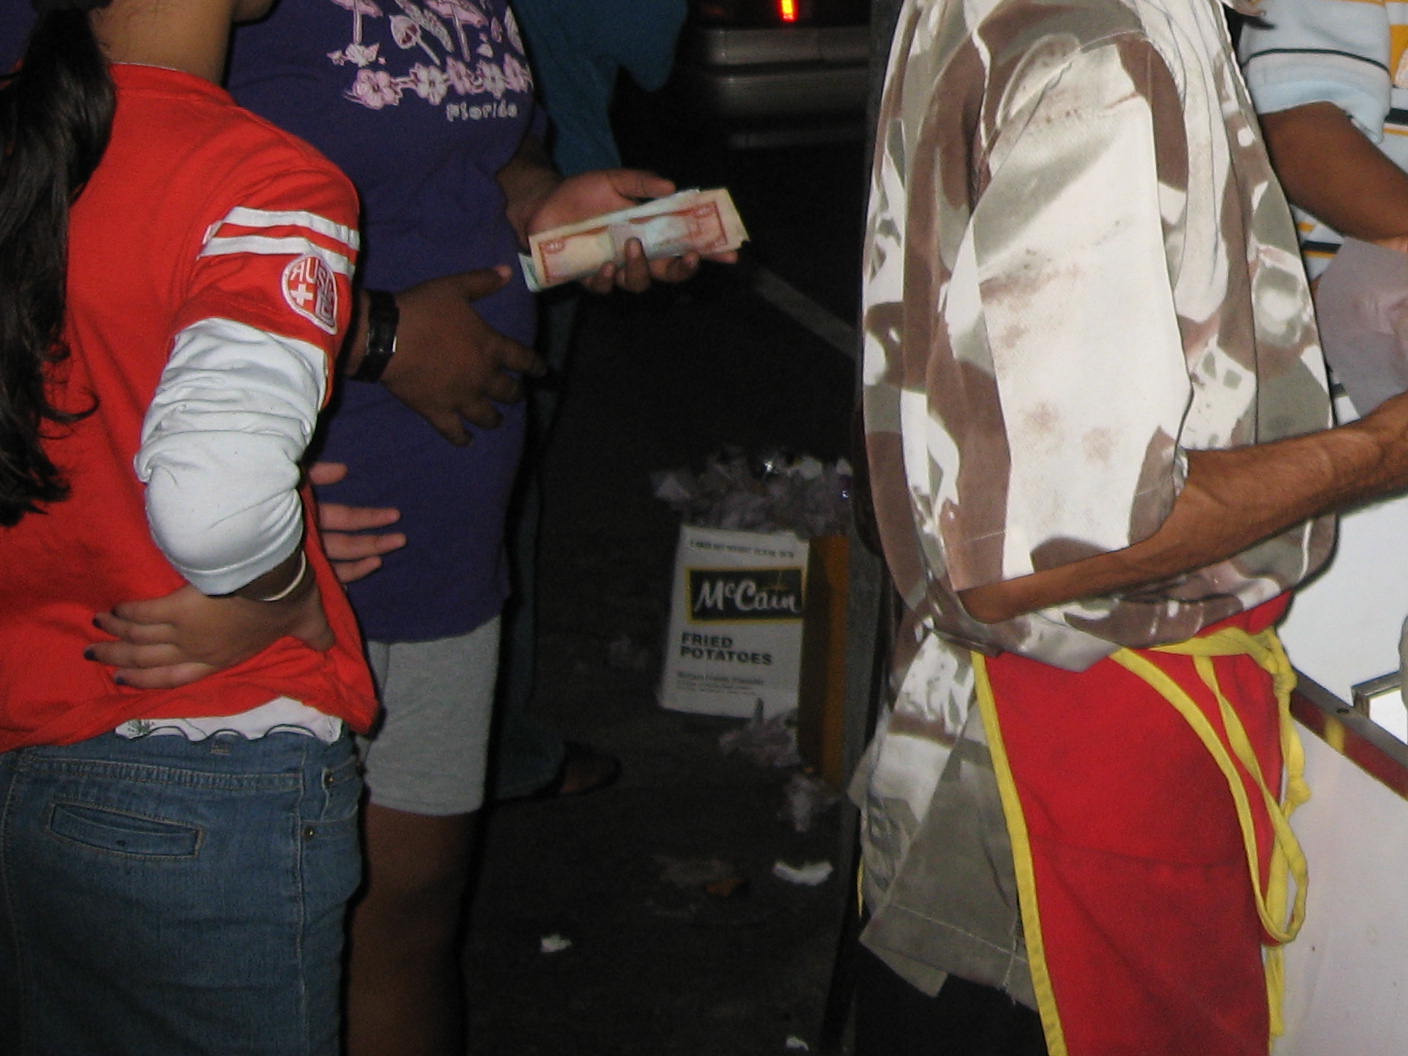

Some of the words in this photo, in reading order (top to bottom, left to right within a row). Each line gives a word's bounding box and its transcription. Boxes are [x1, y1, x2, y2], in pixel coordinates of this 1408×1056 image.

[695, 578, 799, 614] McCain
[681, 631, 733, 649] FRIED
[680, 645, 773, 666] POTATOES
